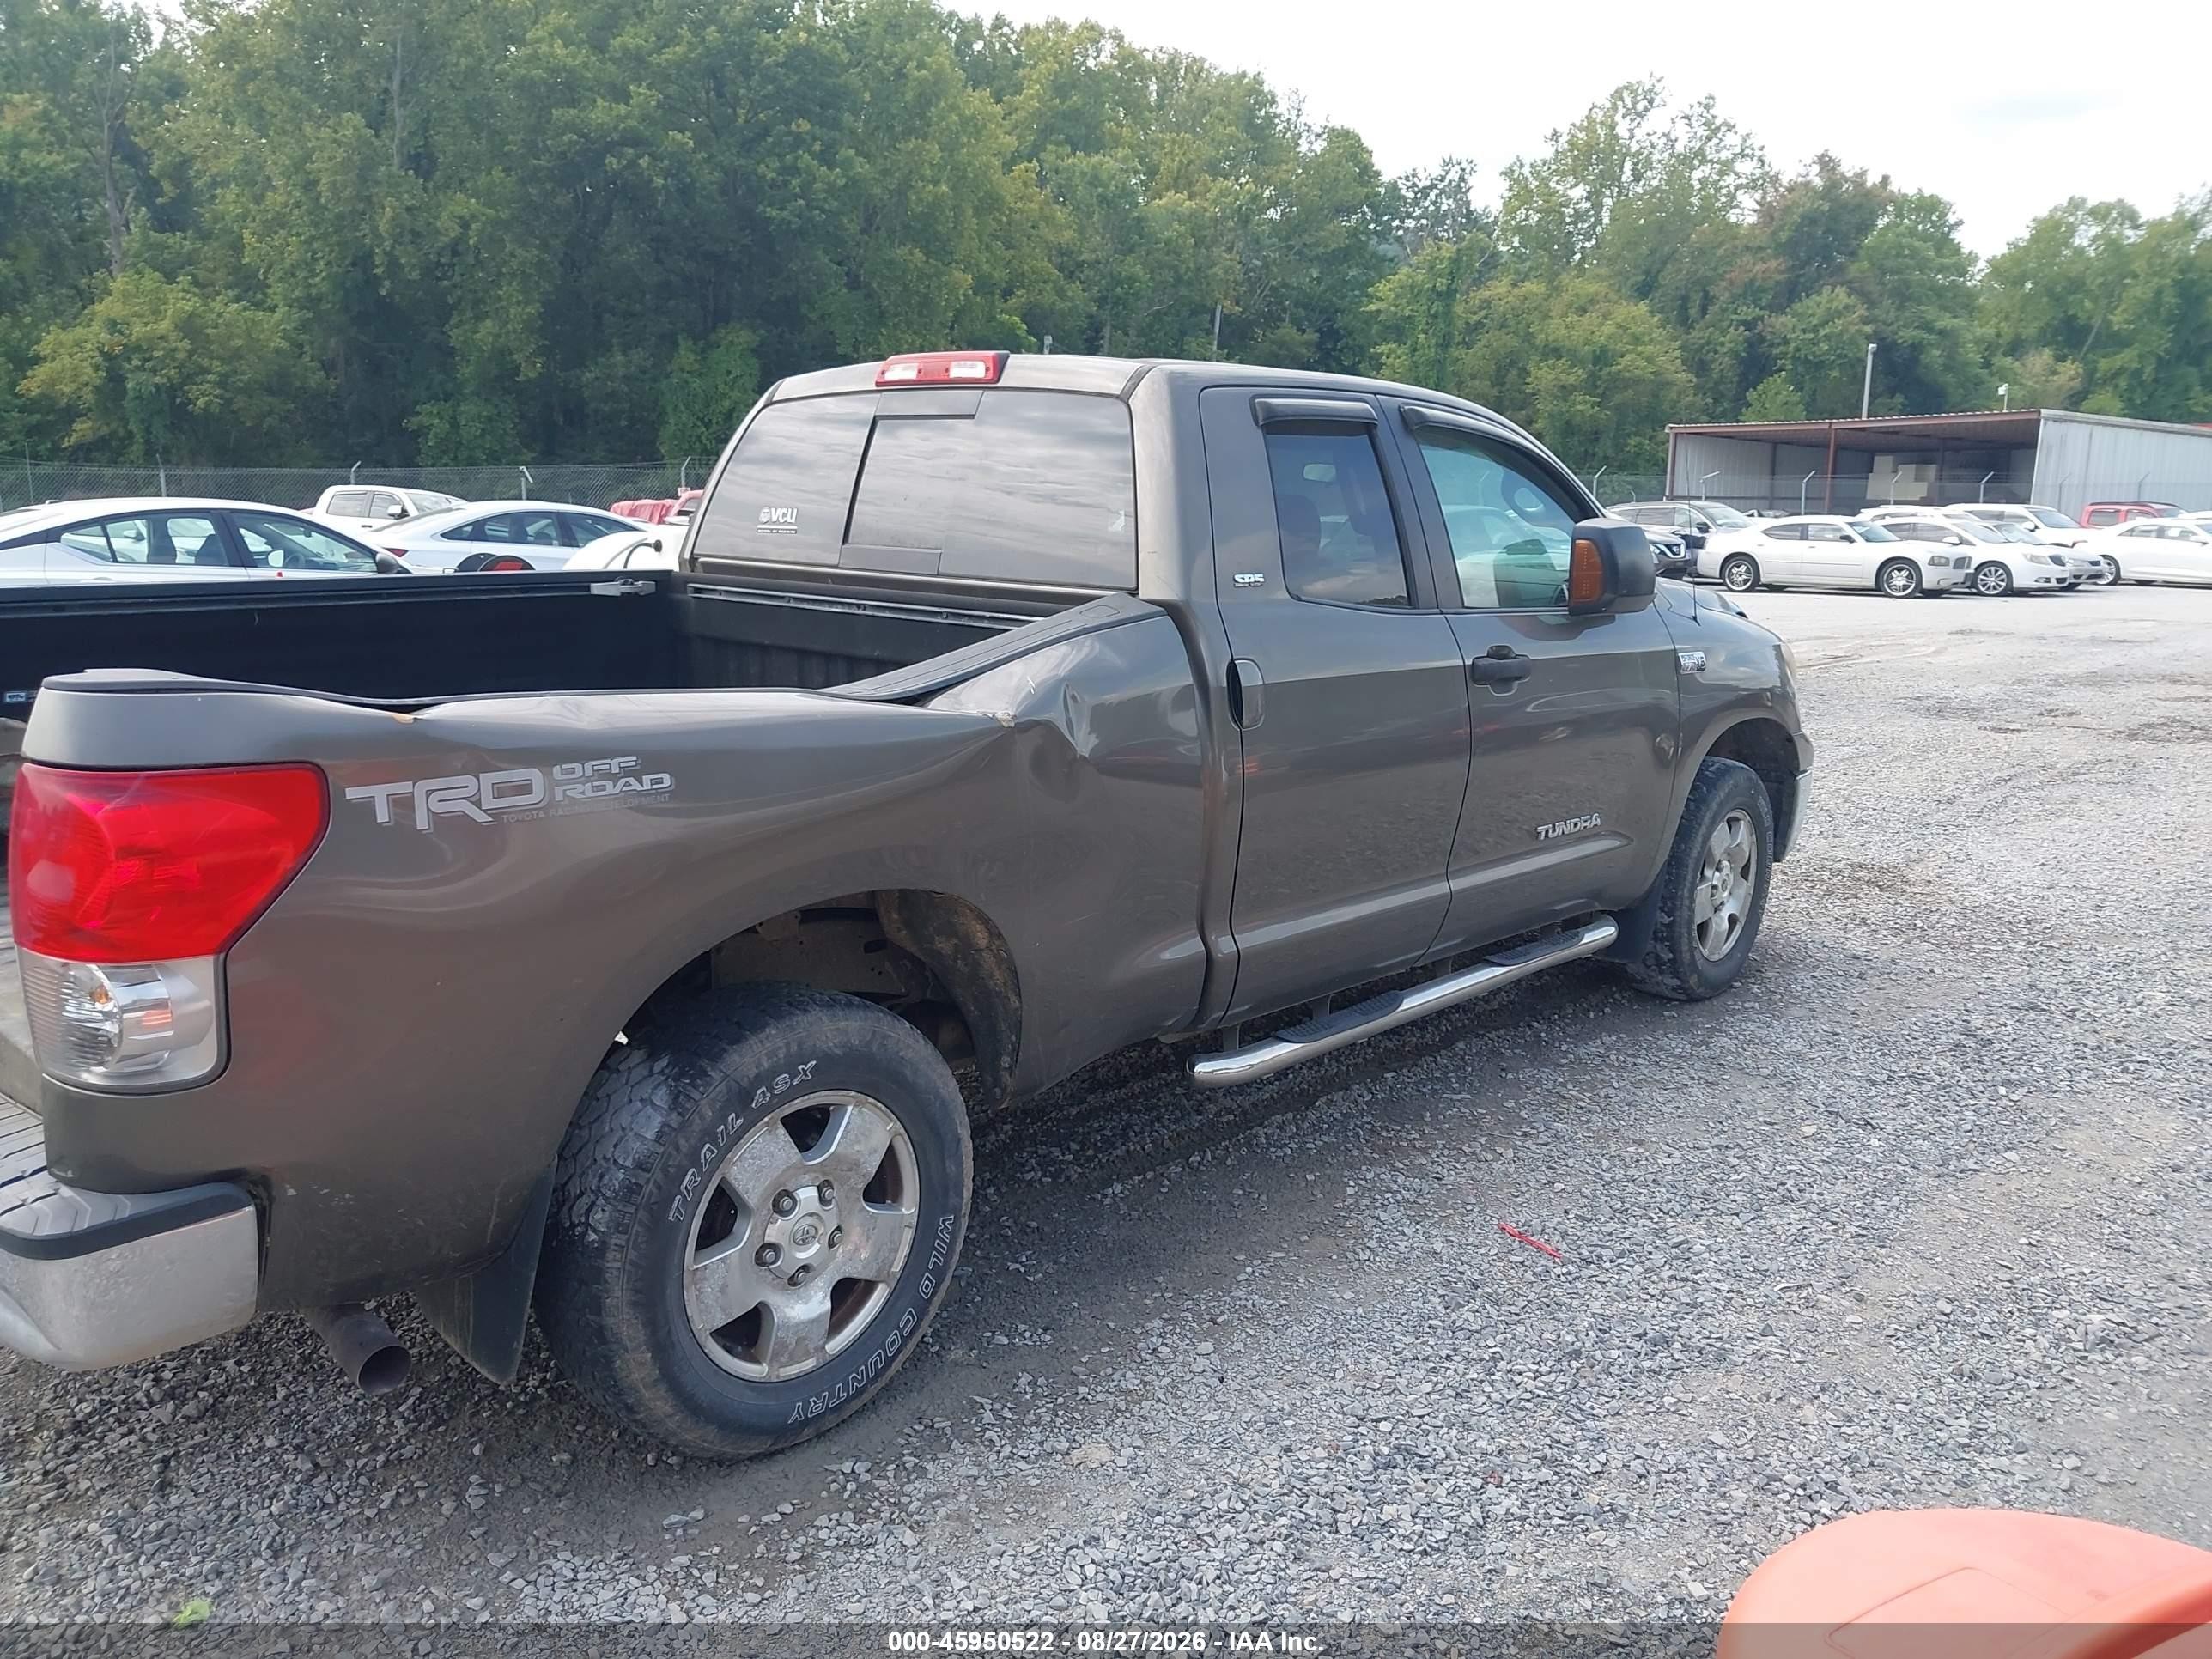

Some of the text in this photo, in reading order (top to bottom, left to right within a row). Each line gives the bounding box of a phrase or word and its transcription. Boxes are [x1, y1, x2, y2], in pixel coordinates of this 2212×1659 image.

[771, 507, 798, 523] VCU
[552, 756, 639, 781] OFF
[345, 768, 547, 831] TRD
[554, 772, 673, 802] ROAD
[1536, 812, 1601, 840] TUNDRA
[668, 1060, 817, 1223] TRAIL 4SX
[787, 1215, 955, 1424] WILD COUNTRY
